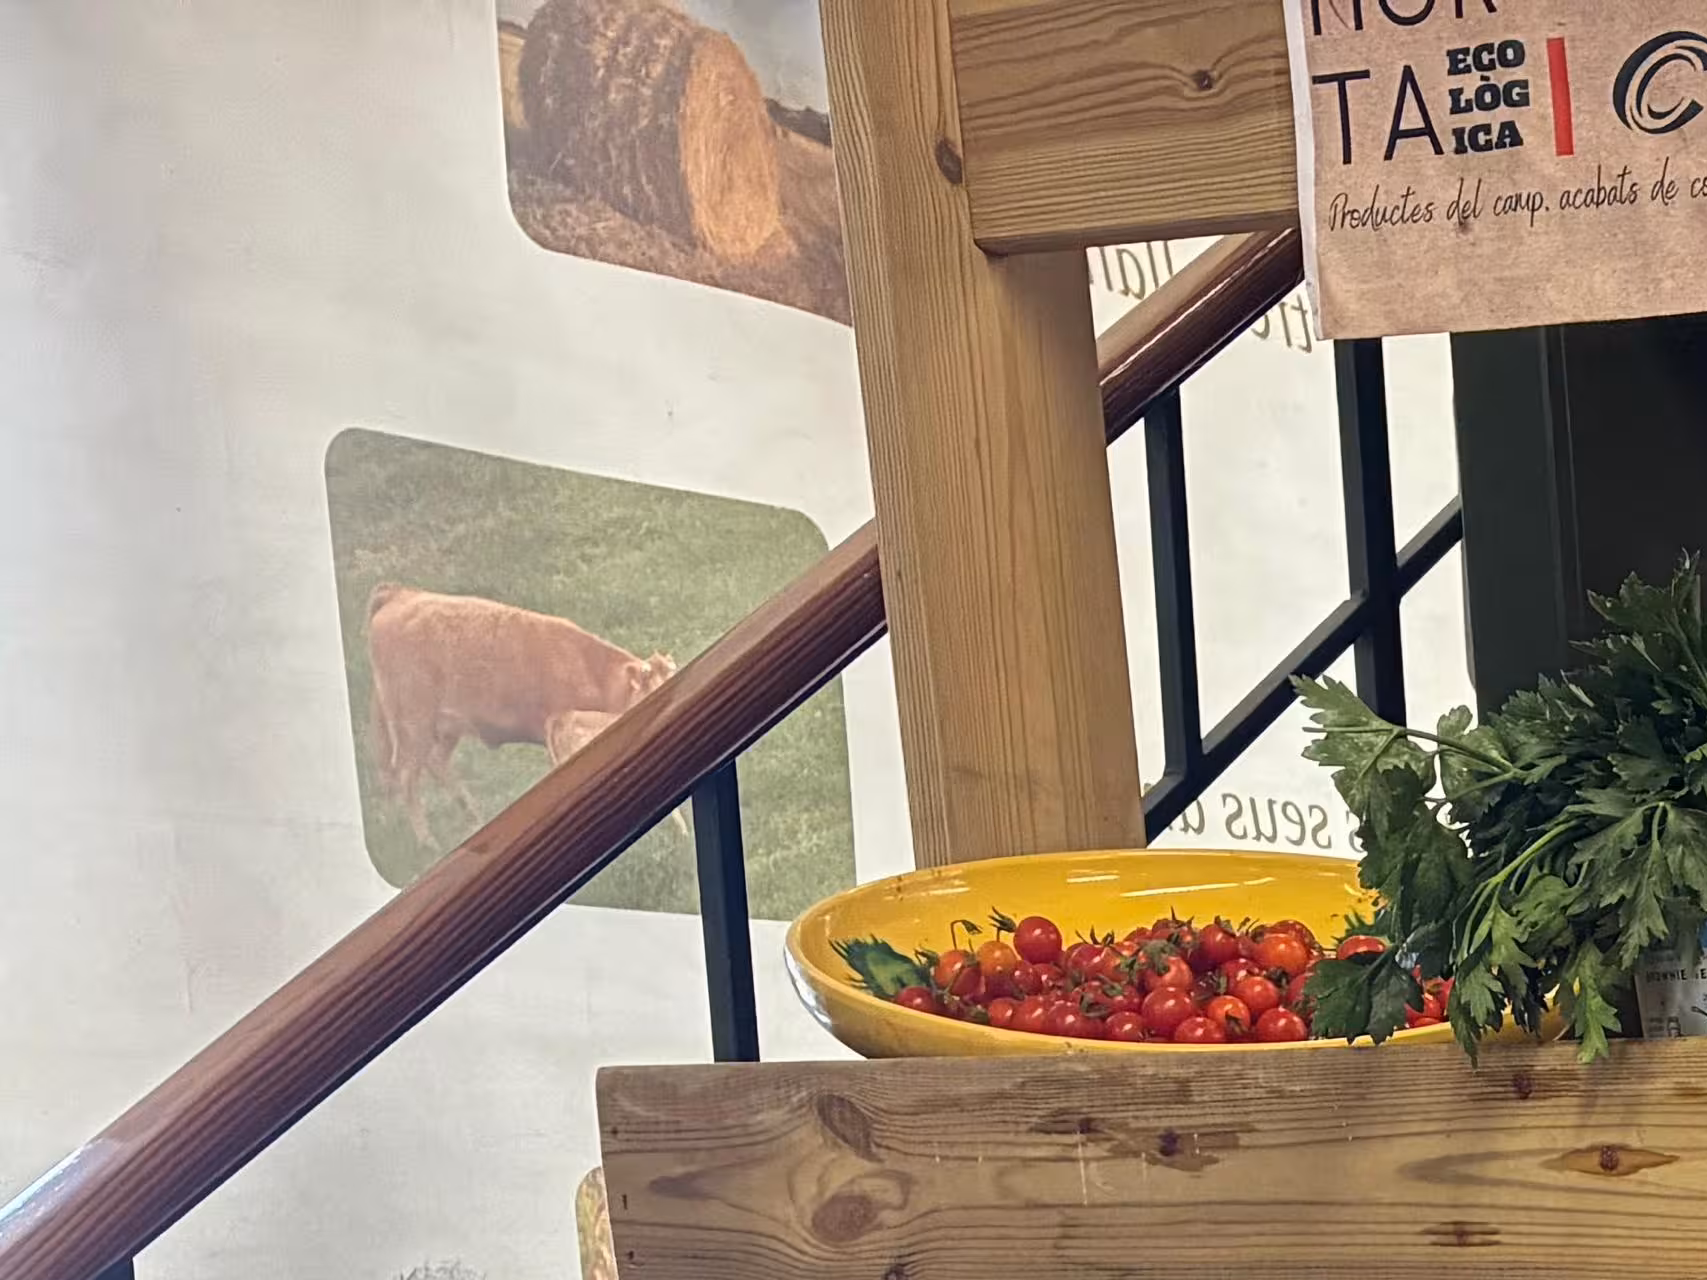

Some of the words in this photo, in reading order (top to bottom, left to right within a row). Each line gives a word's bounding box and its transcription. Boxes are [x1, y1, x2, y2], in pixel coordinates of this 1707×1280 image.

[1446, 39, 1526, 76] ECO
[1312, 64, 1443, 165] TA
[1449, 74, 1530, 115] LÒG
[1452, 120, 1525, 154] ICA
[1327, 184, 1436, 233] Productes
[1446, 178, 1486, 226] del
[1492, 190, 1550, 229] camp.
[1558, 167, 1640, 212] acabats
[1650, 160, 1681, 204] de
